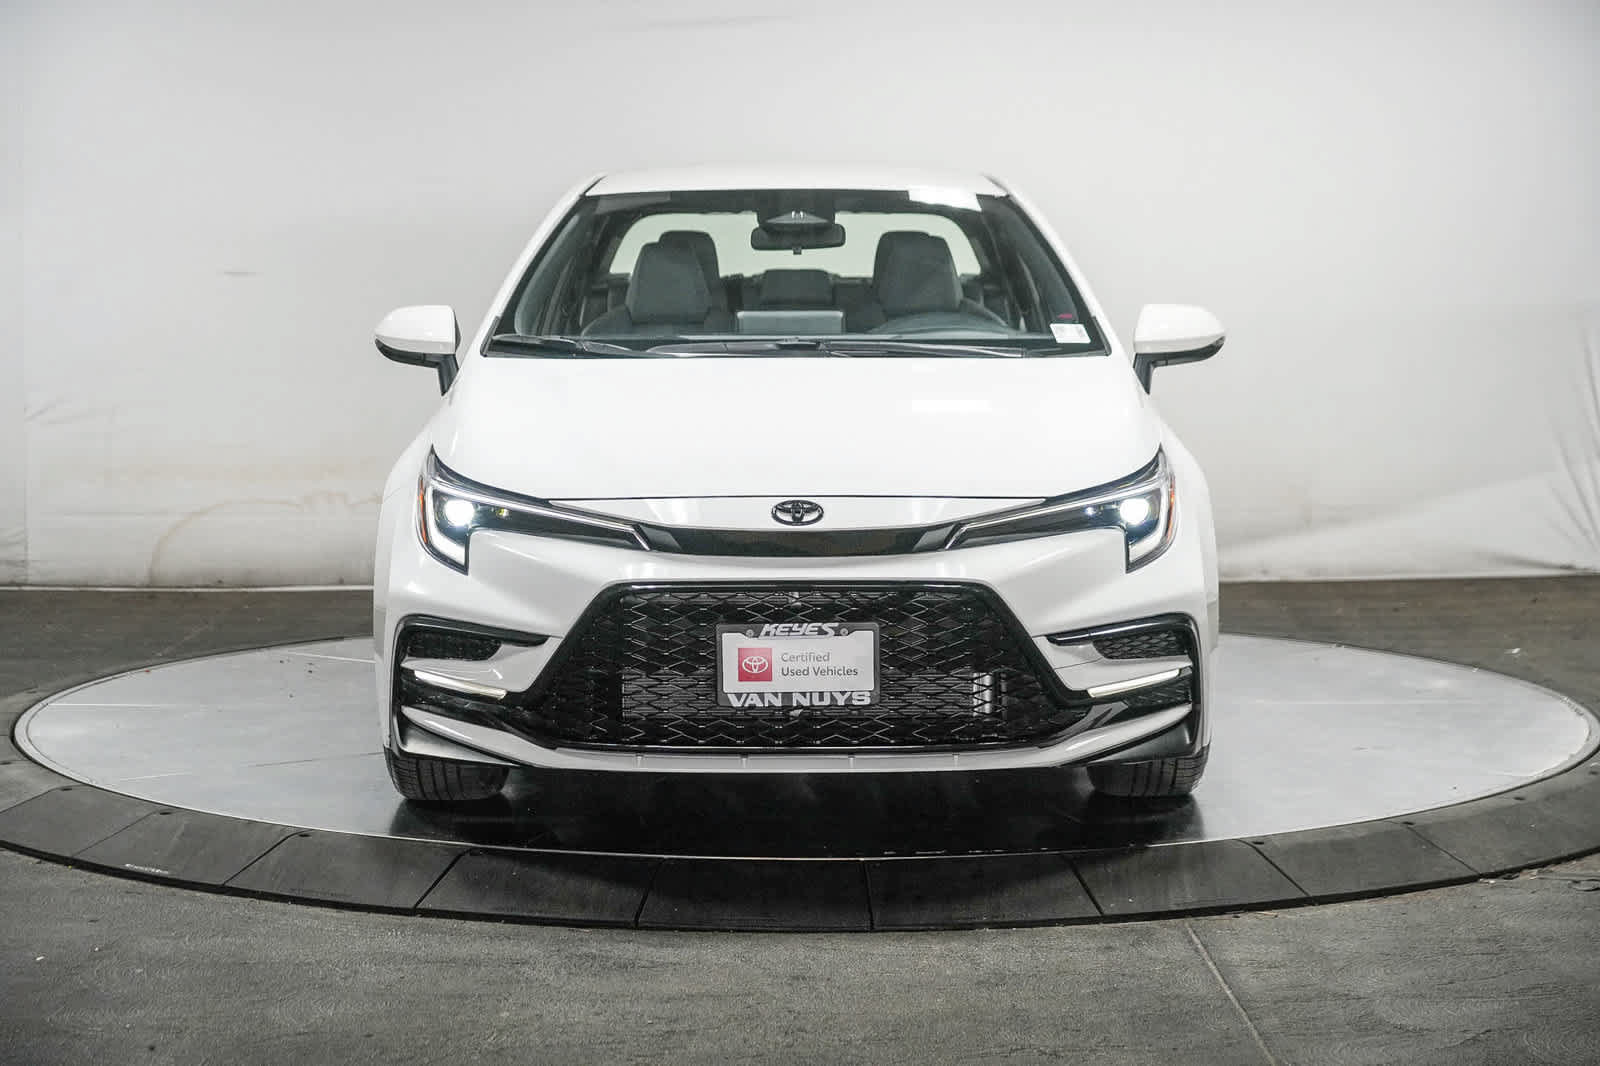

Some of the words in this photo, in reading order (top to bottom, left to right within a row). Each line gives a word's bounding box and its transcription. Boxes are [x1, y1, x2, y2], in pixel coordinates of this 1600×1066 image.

[759, 622, 839, 639] KEYES
[781, 652, 830, 663] Certified
[781, 666, 809, 677] Used
[812, 666, 858, 677] Vehicles
[727, 692, 782, 707] VAN
[792, 691, 871, 706] NUYS
